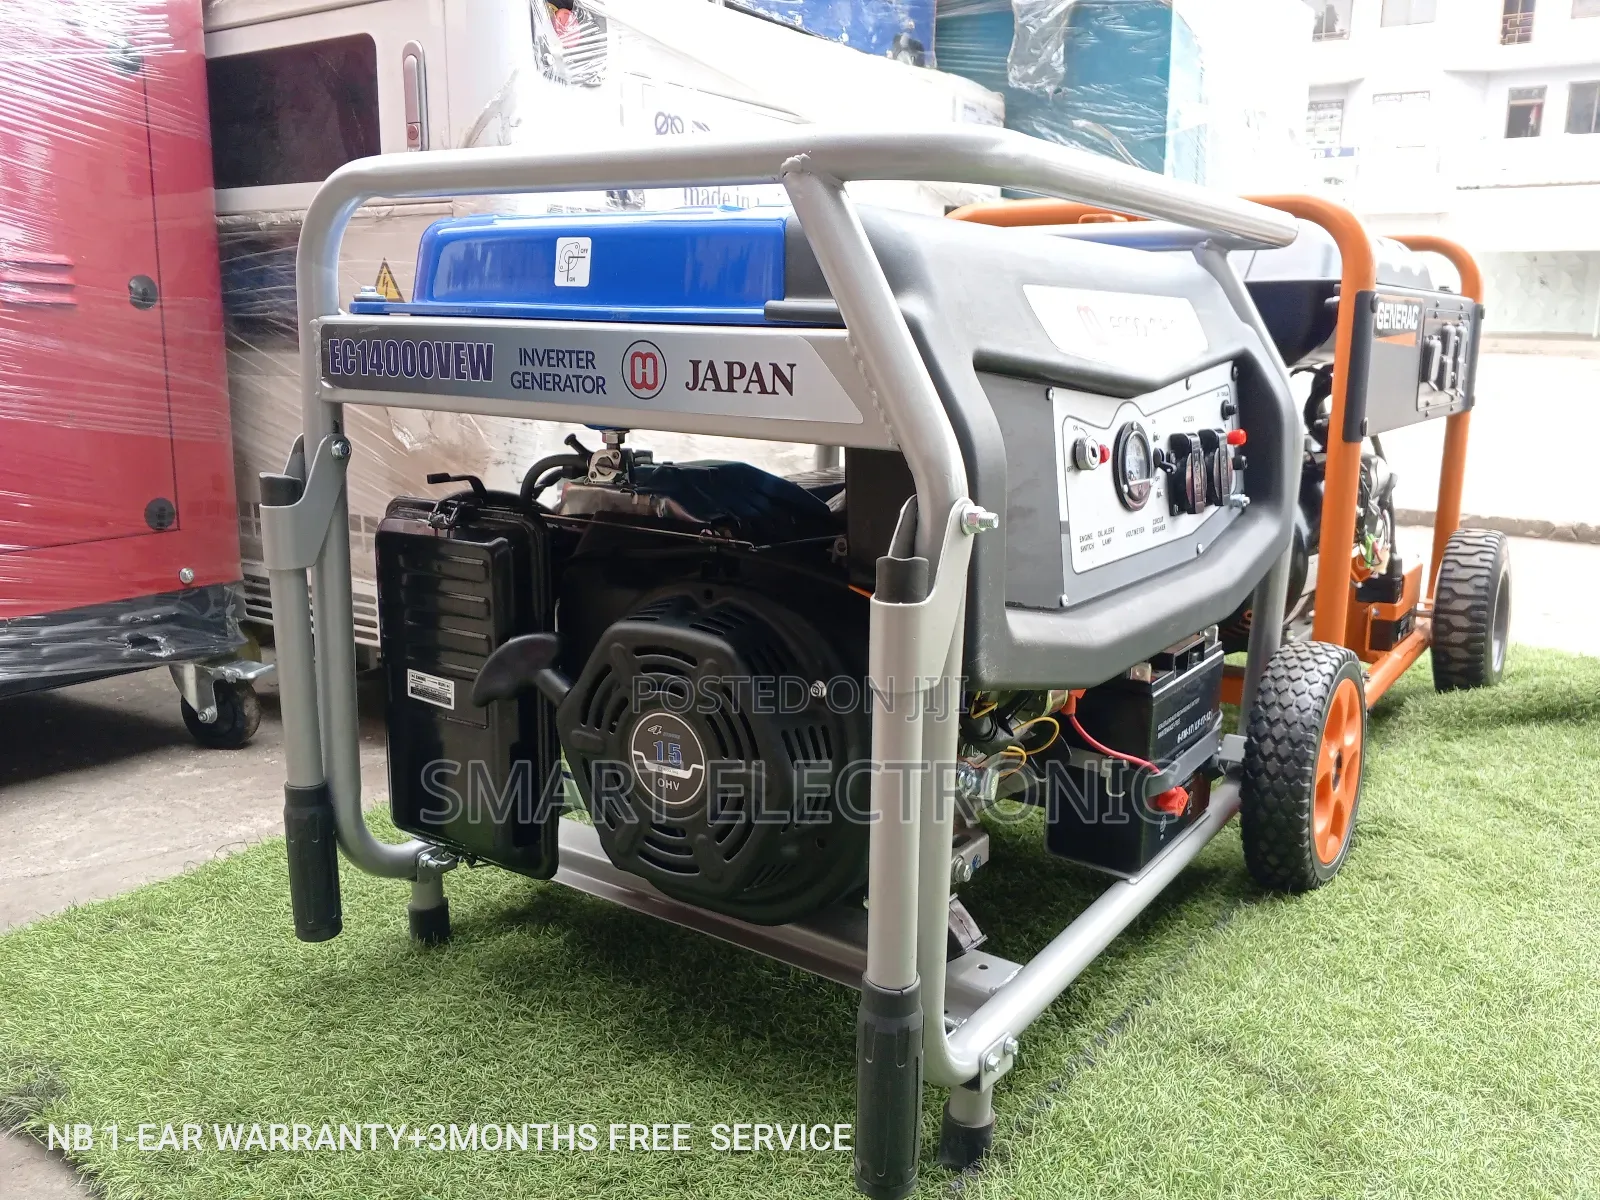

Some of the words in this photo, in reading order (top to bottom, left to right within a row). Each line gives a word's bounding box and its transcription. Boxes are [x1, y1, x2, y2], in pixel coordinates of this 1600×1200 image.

[1376, 302, 1419, 330] GENERAC
[328, 338, 495, 382] EC14000VEW
[518, 347, 597, 370] INVERTER
[510, 371, 607, 395] GENERATOR
[685, 359, 797, 396] JAPAN
[1079, 532, 1093, 543] ENGINE
[1102, 537, 1112, 546] LAMP
[1125, 526, 1145, 538] VOLTMETER
[1080, 542, 1095, 553] SWITCH
[653, 740, 683, 767] 15
[657, 777, 680, 791] OHV
